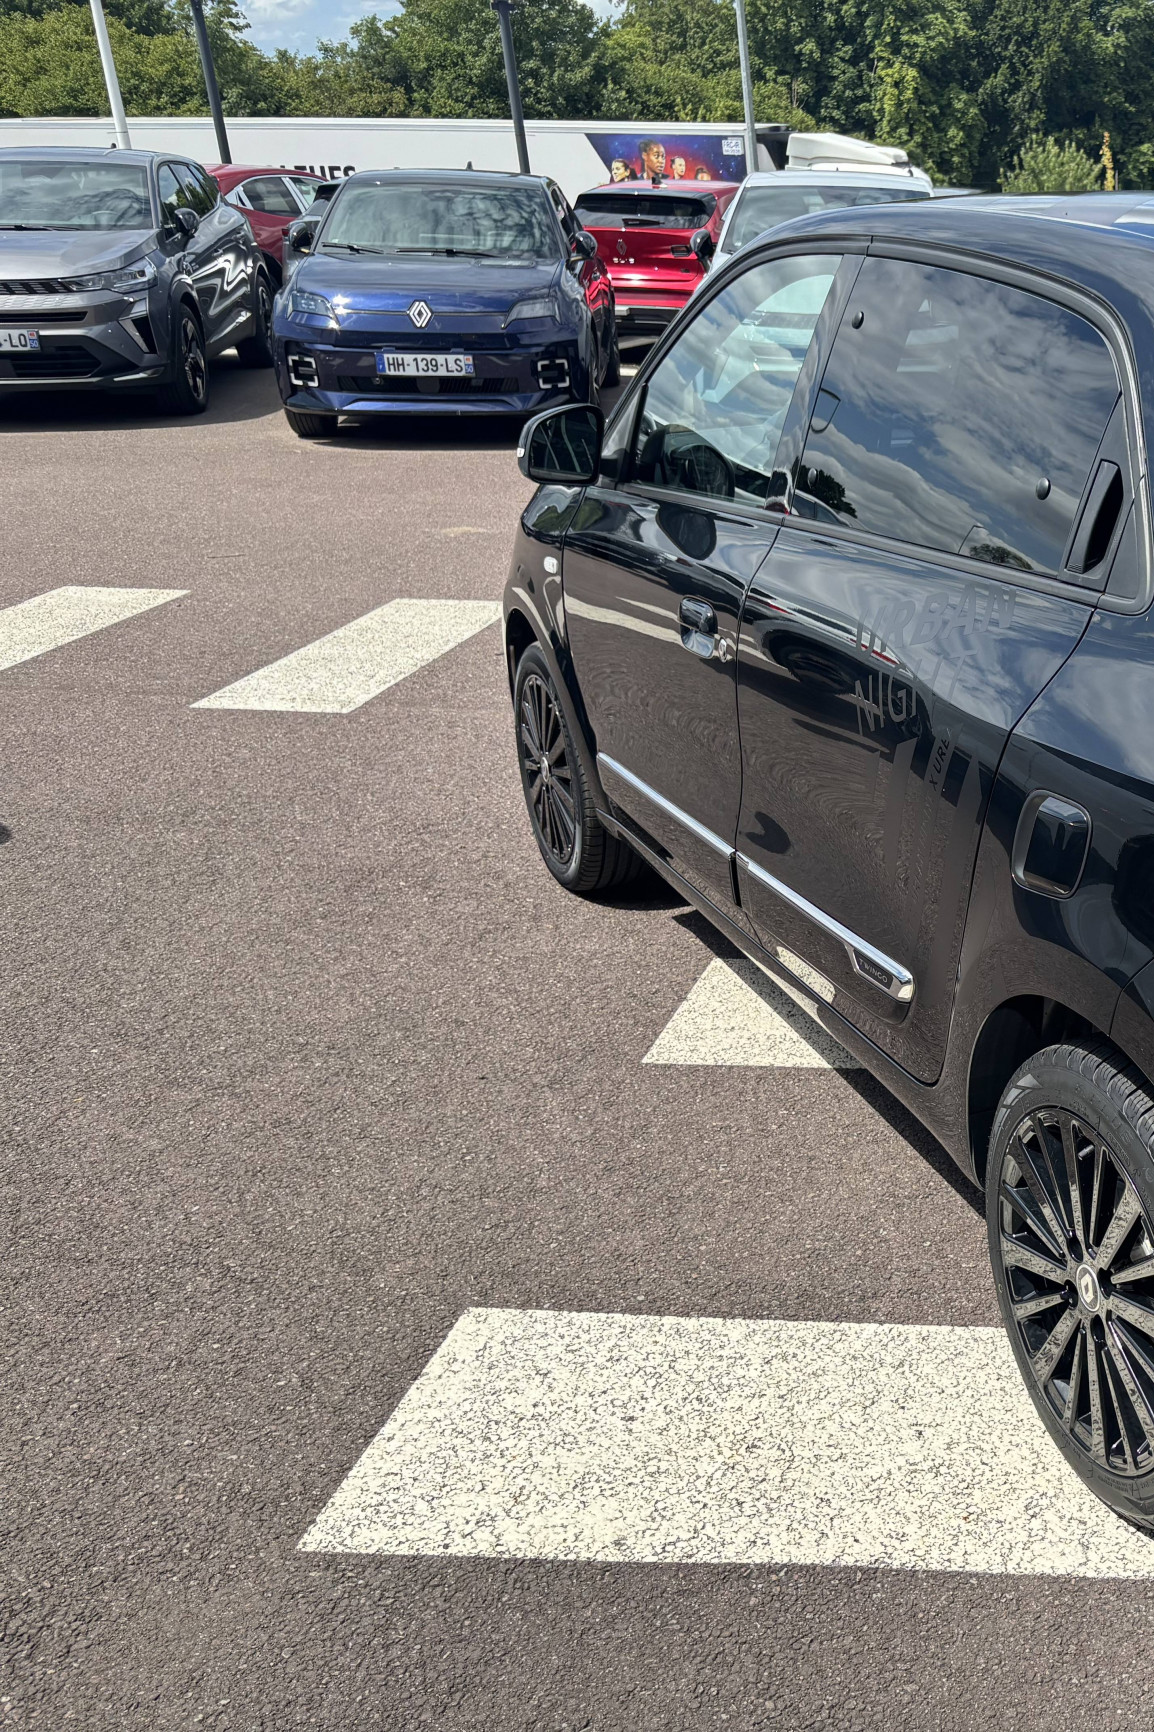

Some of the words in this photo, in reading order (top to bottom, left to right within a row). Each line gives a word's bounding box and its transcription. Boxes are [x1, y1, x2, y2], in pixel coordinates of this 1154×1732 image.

[0, 333, 28, 348] -LQ
[386, 357, 463, 373] HH-139-LS
[465, 365, 473, 373] 50
[856, 582, 1017, 658] URBAN
[855, 649, 979, 736] NIGHT
[859, 957, 888, 983] TWINGO
